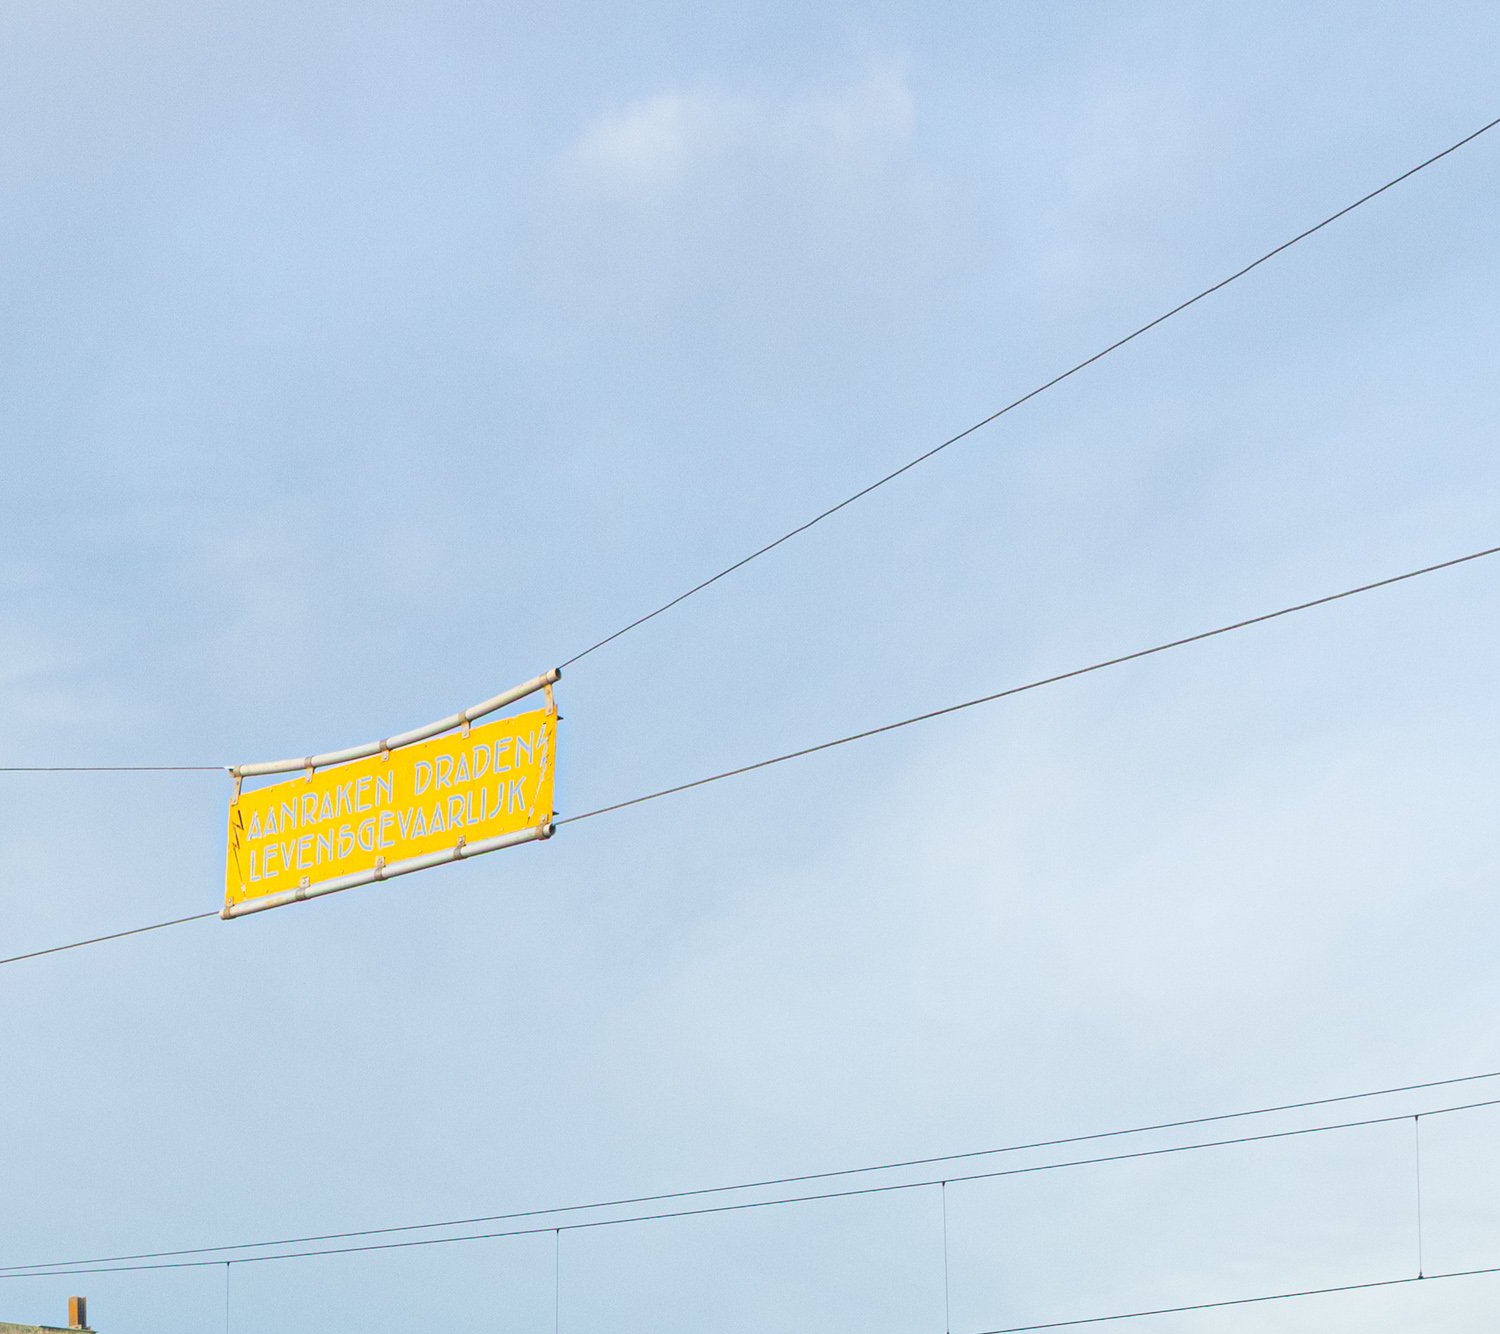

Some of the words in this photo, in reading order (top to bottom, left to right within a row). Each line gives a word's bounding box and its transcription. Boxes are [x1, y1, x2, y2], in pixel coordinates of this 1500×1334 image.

[247, 770, 393, 842] AANRAKEN
[414, 730, 535, 796] DRADEN
[249, 776, 526, 882] LEVENSGEVAARLIJK
